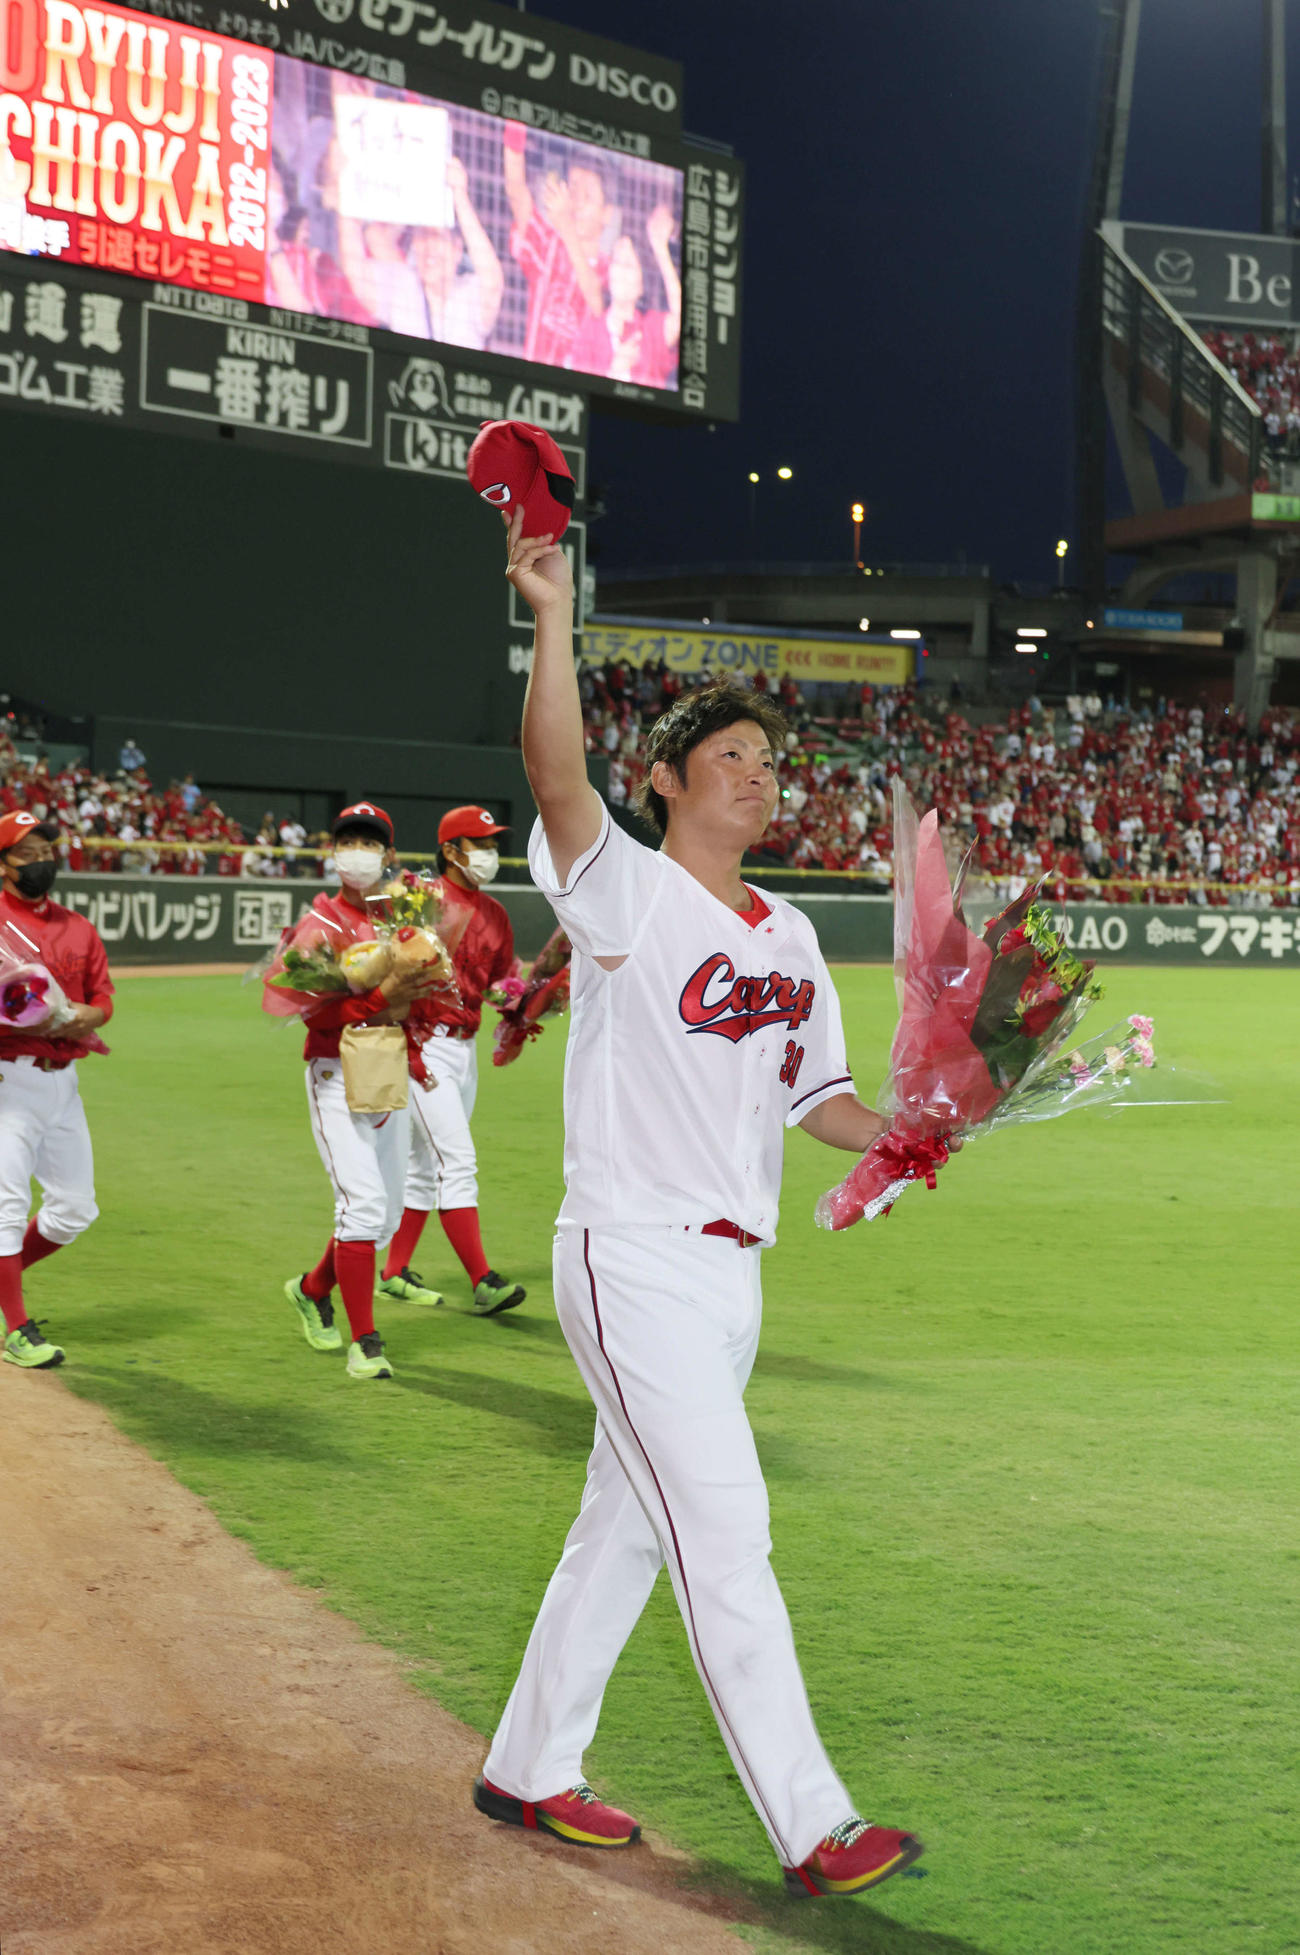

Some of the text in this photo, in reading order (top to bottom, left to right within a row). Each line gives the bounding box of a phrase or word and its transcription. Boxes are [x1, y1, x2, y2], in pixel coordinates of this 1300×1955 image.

[42, 0, 224, 143] RYUJI
[568, 54, 678, 113] DISCO
[227, 54, 269, 251] 2012-2023
[77, 217, 261, 289] 引退セレモニー
[226, 326, 297, 366] KIRIN
[166, 356, 350, 436] 一番搾り
[701, 639, 779, 669] ZONE
[679, 952, 816, 1043] Carp
[779, 1040, 805, 1088] 30
